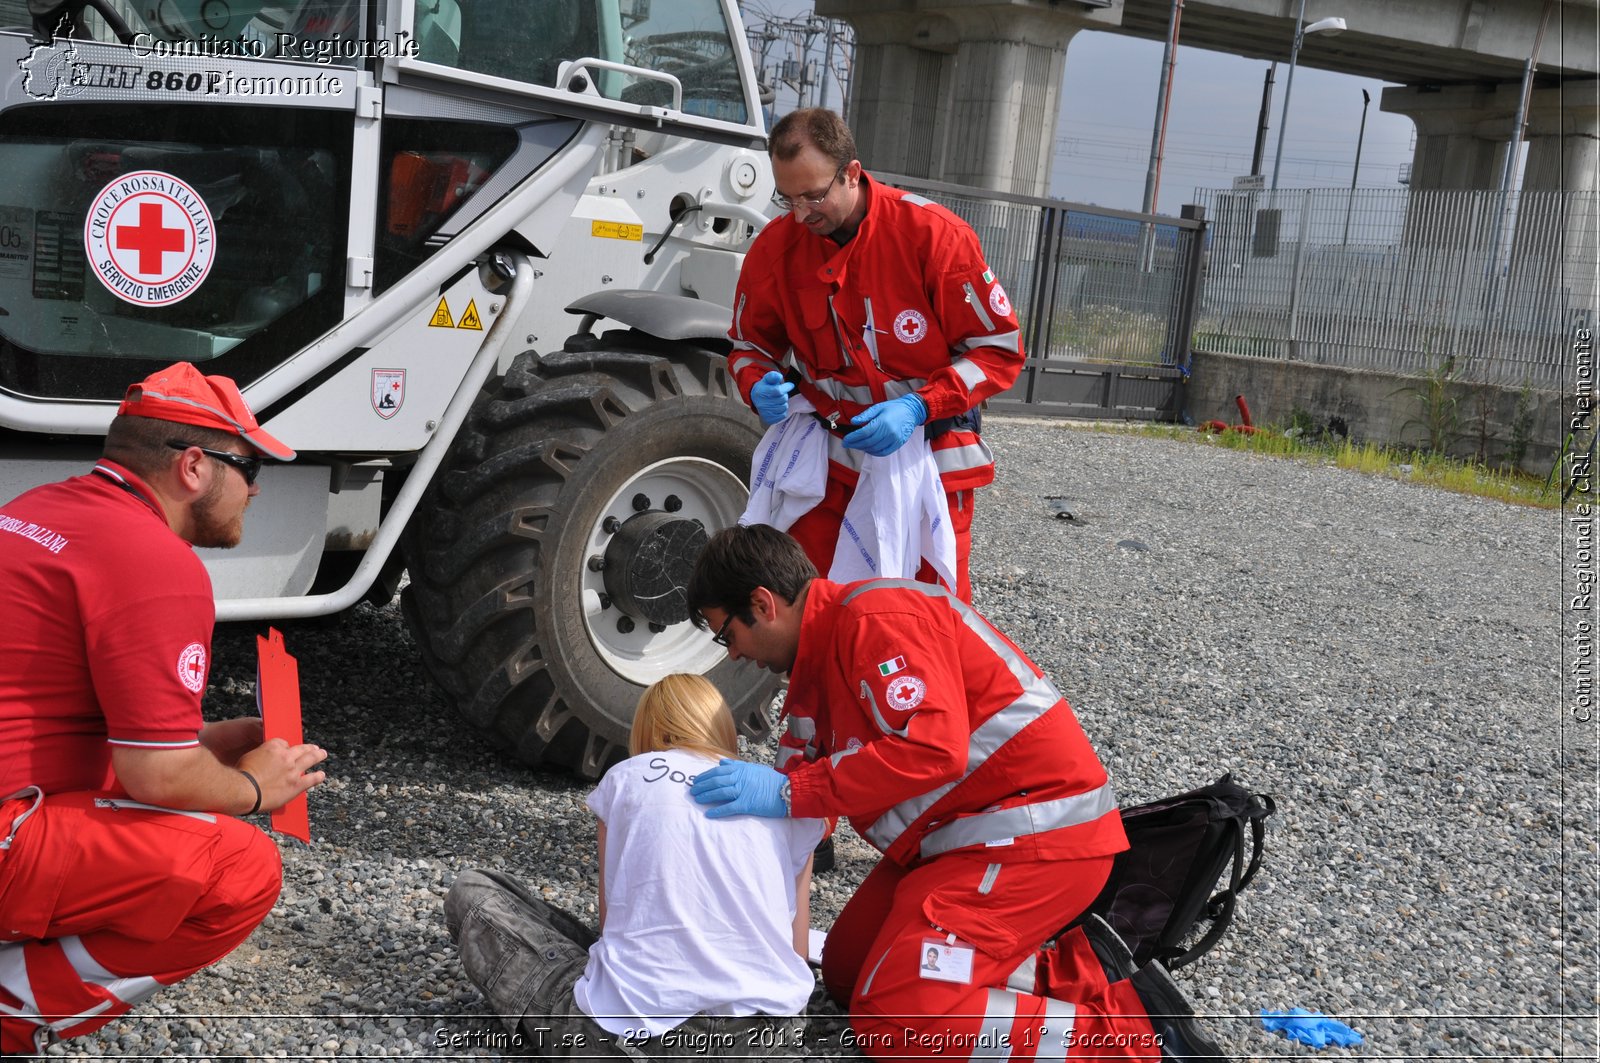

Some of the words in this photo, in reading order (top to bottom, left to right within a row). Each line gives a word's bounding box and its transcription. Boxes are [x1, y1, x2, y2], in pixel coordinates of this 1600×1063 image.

[146, 71, 202, 92] 860
[92, 189, 121, 239] CROCE
[121, 176, 165, 196] ROSSA
[168, 182, 210, 245] ITALIANA
[99, 259, 143, 299] SERVIZIO
[147, 262, 204, 300] EMERGENZE
[754, 441, 777, 488] LAVANDERIA
[19, 522, 69, 554] ITALIANA
